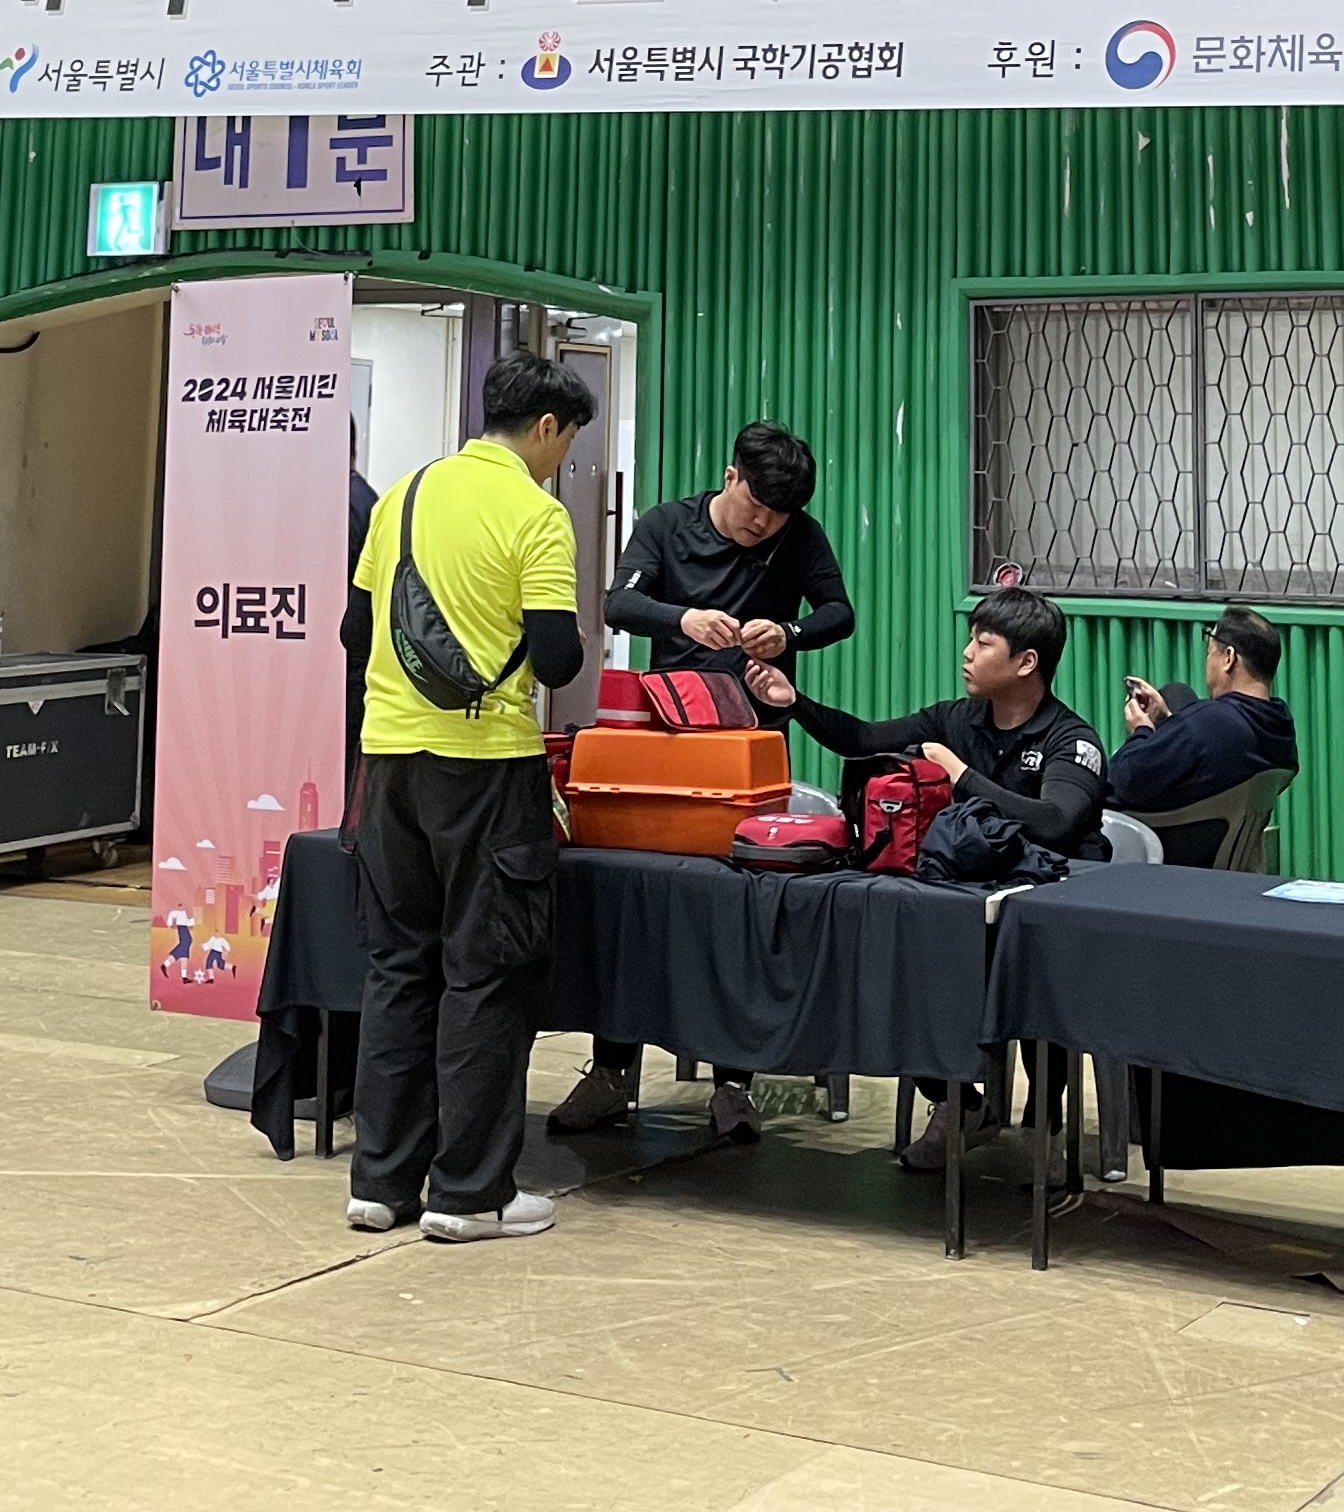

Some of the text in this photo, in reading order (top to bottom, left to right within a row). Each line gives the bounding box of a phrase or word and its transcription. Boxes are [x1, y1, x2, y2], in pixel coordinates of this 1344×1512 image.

[37, 54, 165, 95] 서울특별시
[229, 58, 363, 82] 서울특별시체육회
[425, 53, 485, 88] 주관
[587, 39, 904, 84] 서울특별시 국학기공협회
[987, 38, 1057, 80] 후원
[182, 374, 337, 402] 2024 서울시민
[206, 407, 311, 433] 체육대축전
[193, 582, 308, 641] 의료진
